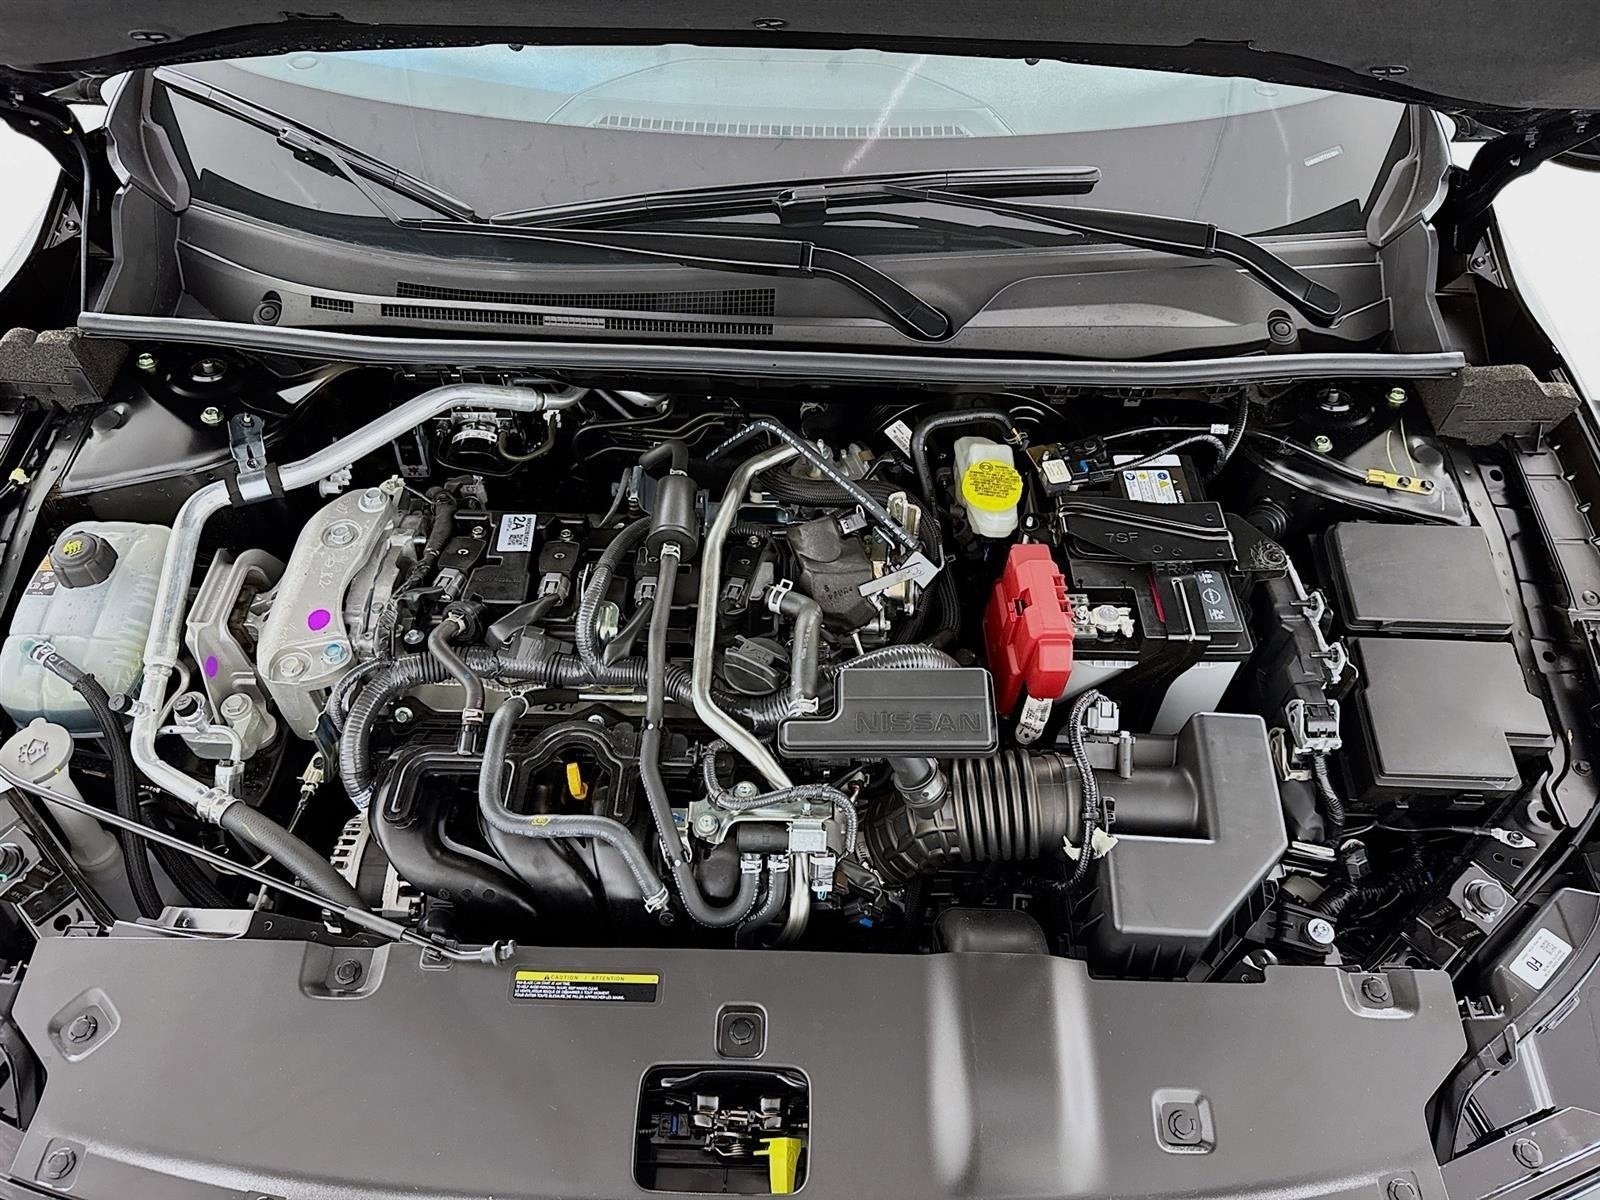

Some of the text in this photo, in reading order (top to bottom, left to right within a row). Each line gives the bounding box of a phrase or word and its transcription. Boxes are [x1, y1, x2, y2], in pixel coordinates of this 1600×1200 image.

[512, 516, 527, 530] 2A
[1105, 532, 1139, 543] 7SF
[855, 712, 982, 733] NISSAN
